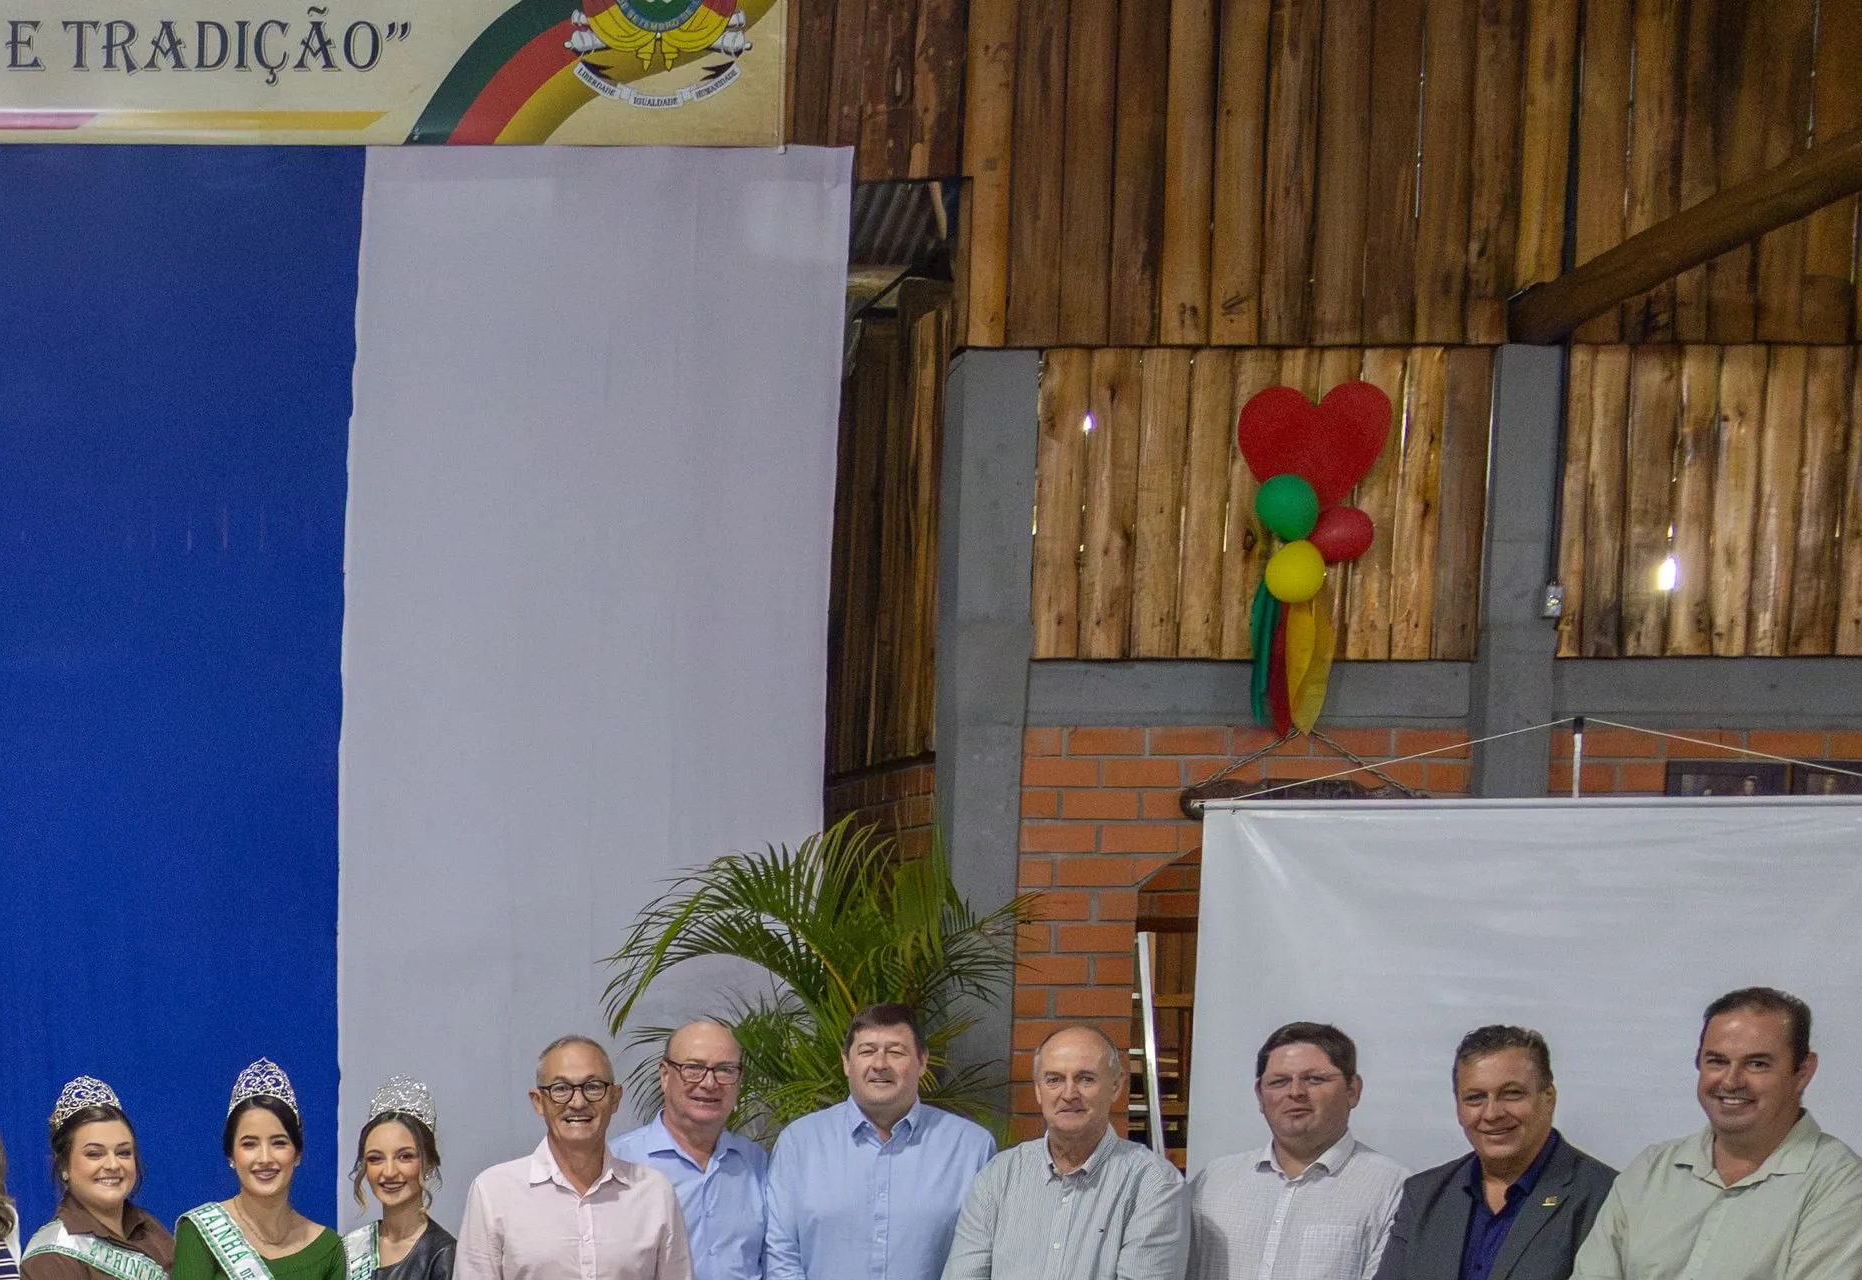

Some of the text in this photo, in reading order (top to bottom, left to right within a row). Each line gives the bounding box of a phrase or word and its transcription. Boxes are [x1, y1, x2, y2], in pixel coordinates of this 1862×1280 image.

[5, 20, 46, 71] E
[577, 67, 617, 97] LIBERDADE
[695, 68, 738, 99] HUMANIDADE
[633, 96, 679, 108] IGUALDADE
[195, 1204, 251, 1265] RAINHA
